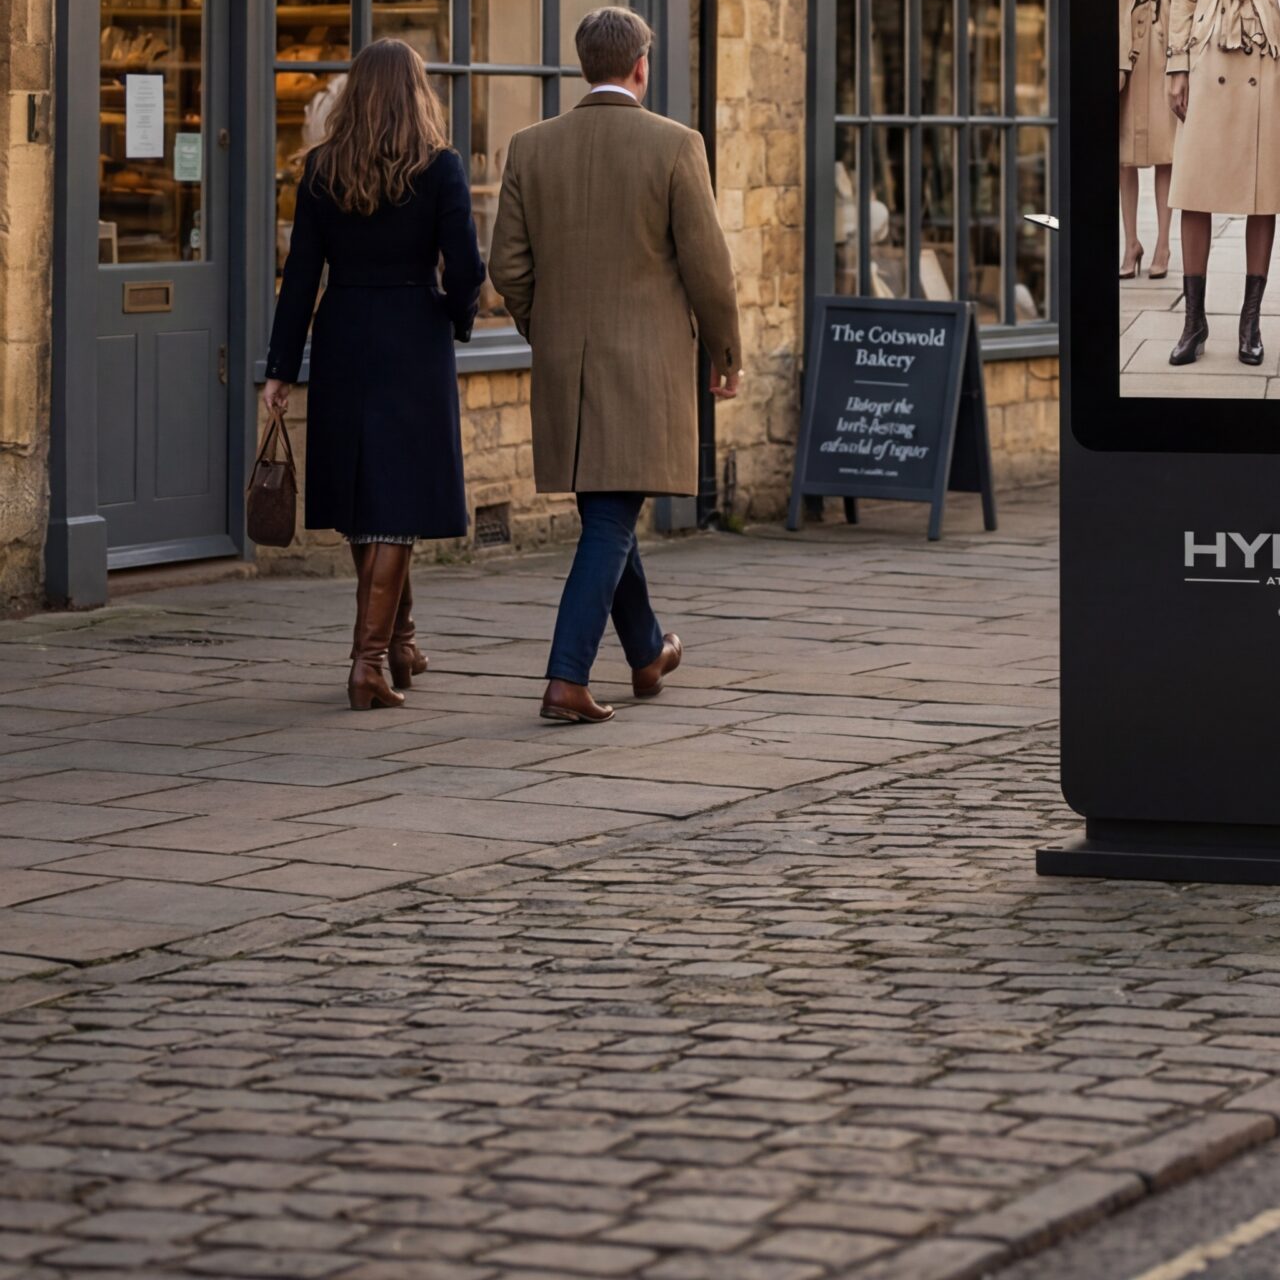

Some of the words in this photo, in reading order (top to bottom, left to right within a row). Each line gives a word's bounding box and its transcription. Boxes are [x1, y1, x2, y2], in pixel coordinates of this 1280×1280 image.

[831, 324, 864, 342] The
[868, 326, 946, 346] Cotswold
[855, 348, 915, 373] Bakery
